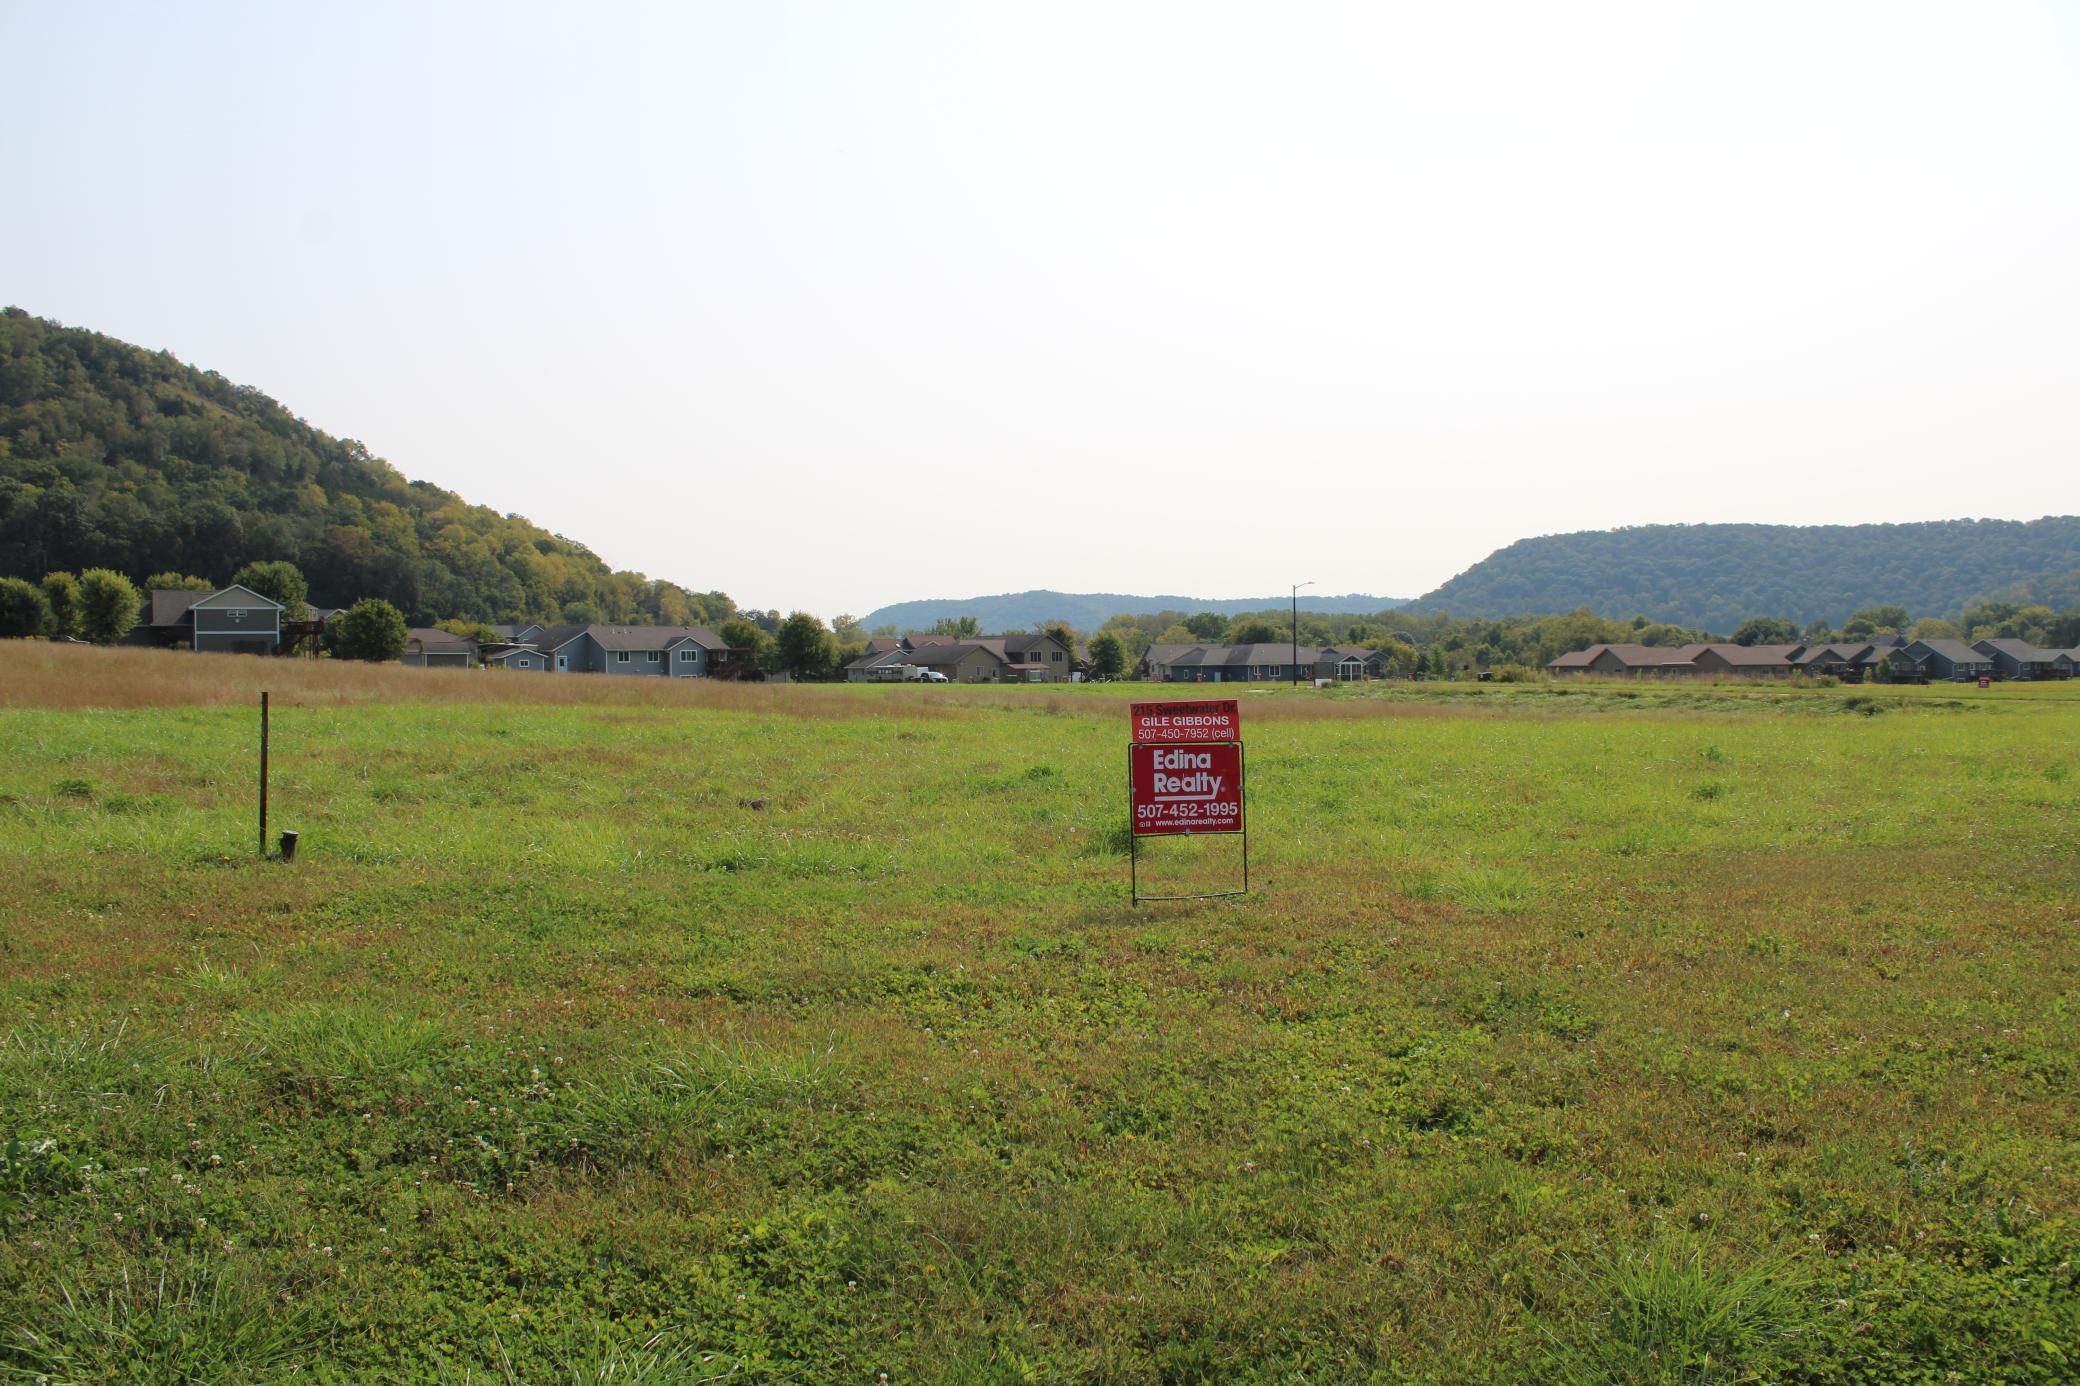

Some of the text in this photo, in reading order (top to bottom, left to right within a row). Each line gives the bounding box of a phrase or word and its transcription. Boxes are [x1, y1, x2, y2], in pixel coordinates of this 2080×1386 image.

[1134, 705, 1153, 716] 215
[1156, 703, 1219, 715] Sweetwater
[1141, 715, 1230, 726] GILE GIBBONS
[1138, 727, 1235, 739] 507-450-7952 (cell)
[1153, 749, 1211, 769] Edina
[1154, 772, 1222, 801] Realty
[1137, 802, 1238, 818] 507-452-1995
[1155, 817, 1234, 827] www.edinarealty.com
